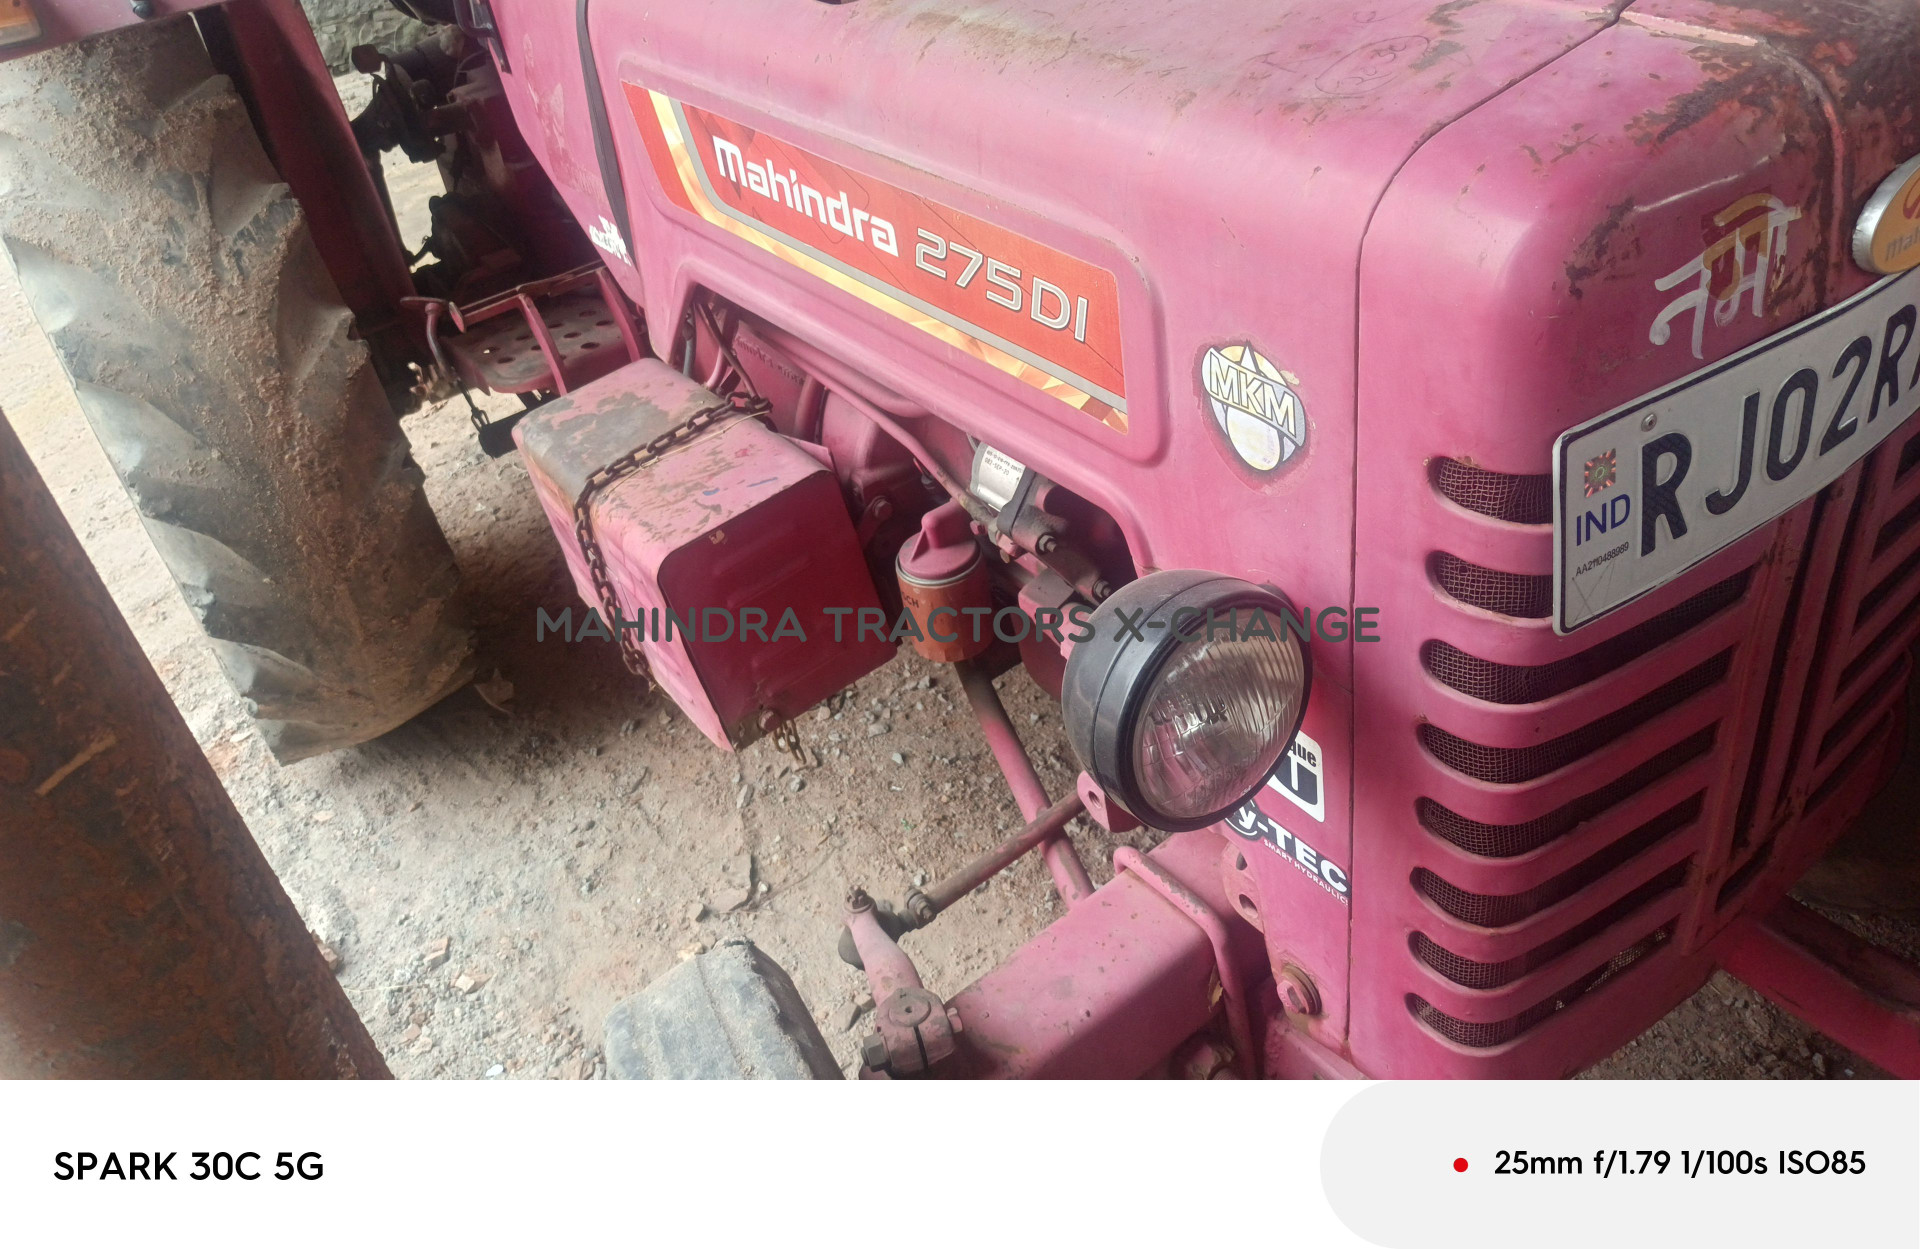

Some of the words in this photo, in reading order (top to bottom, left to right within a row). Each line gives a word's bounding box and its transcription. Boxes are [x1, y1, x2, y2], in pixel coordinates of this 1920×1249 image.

[1209, 351, 1297, 439] MKM
[1640, 303, 1920, 558] RJ02R
[1576, 493, 1631, 547] IND
[1263, 838, 1293, 864] SMART
